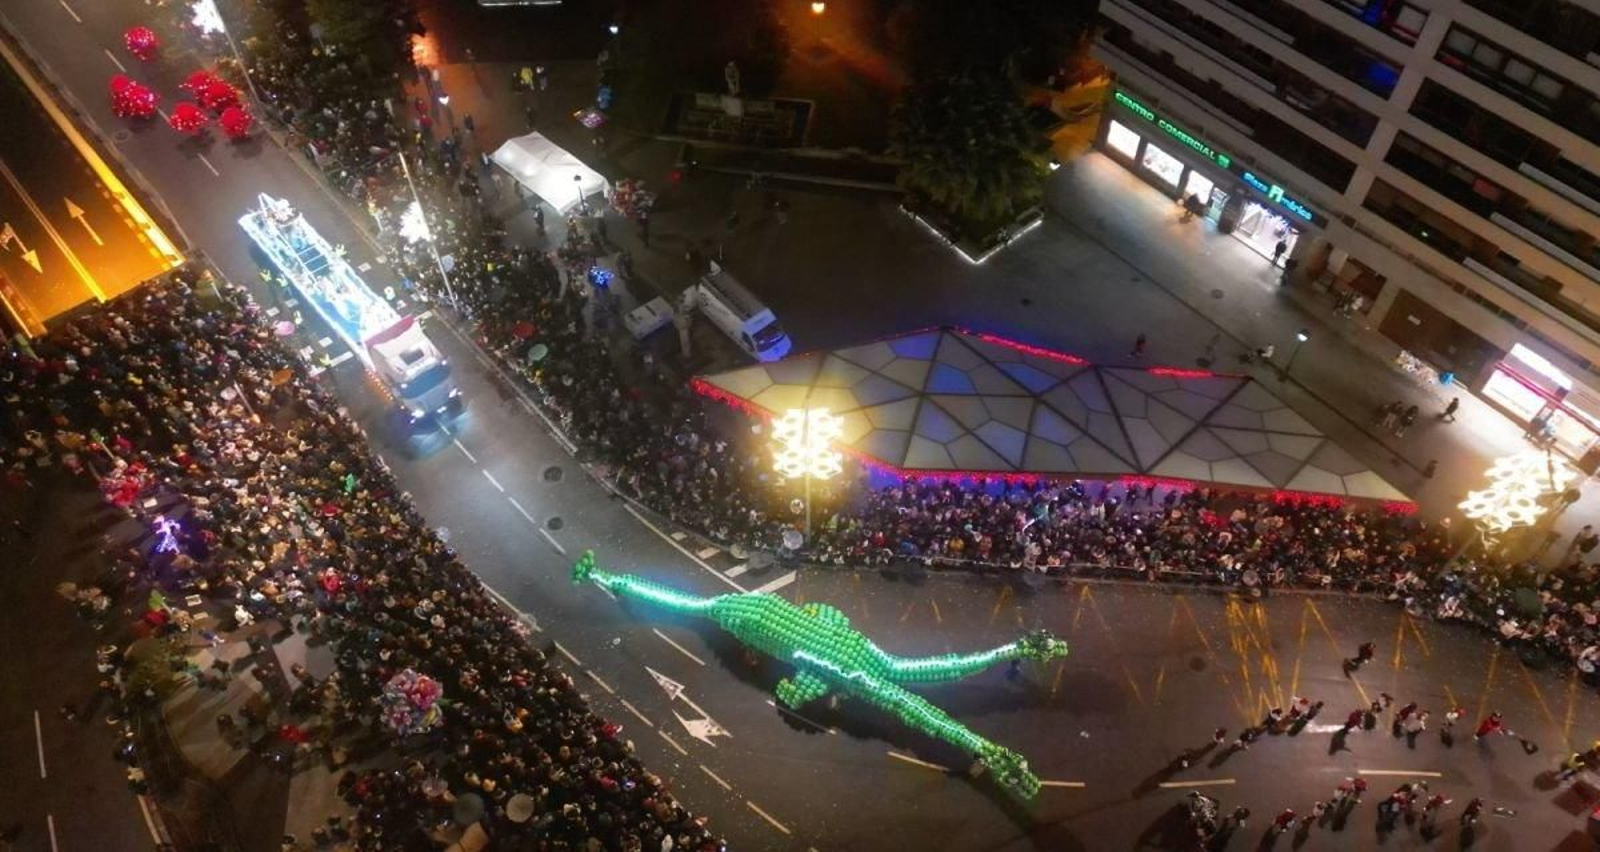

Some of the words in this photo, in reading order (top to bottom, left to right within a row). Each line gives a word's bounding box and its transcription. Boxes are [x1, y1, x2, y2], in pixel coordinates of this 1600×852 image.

[1115, 92, 1155, 121] CENTRO
[1158, 119, 1216, 160] COMERCIAL
[1244, 172, 1268, 193] Plaza
